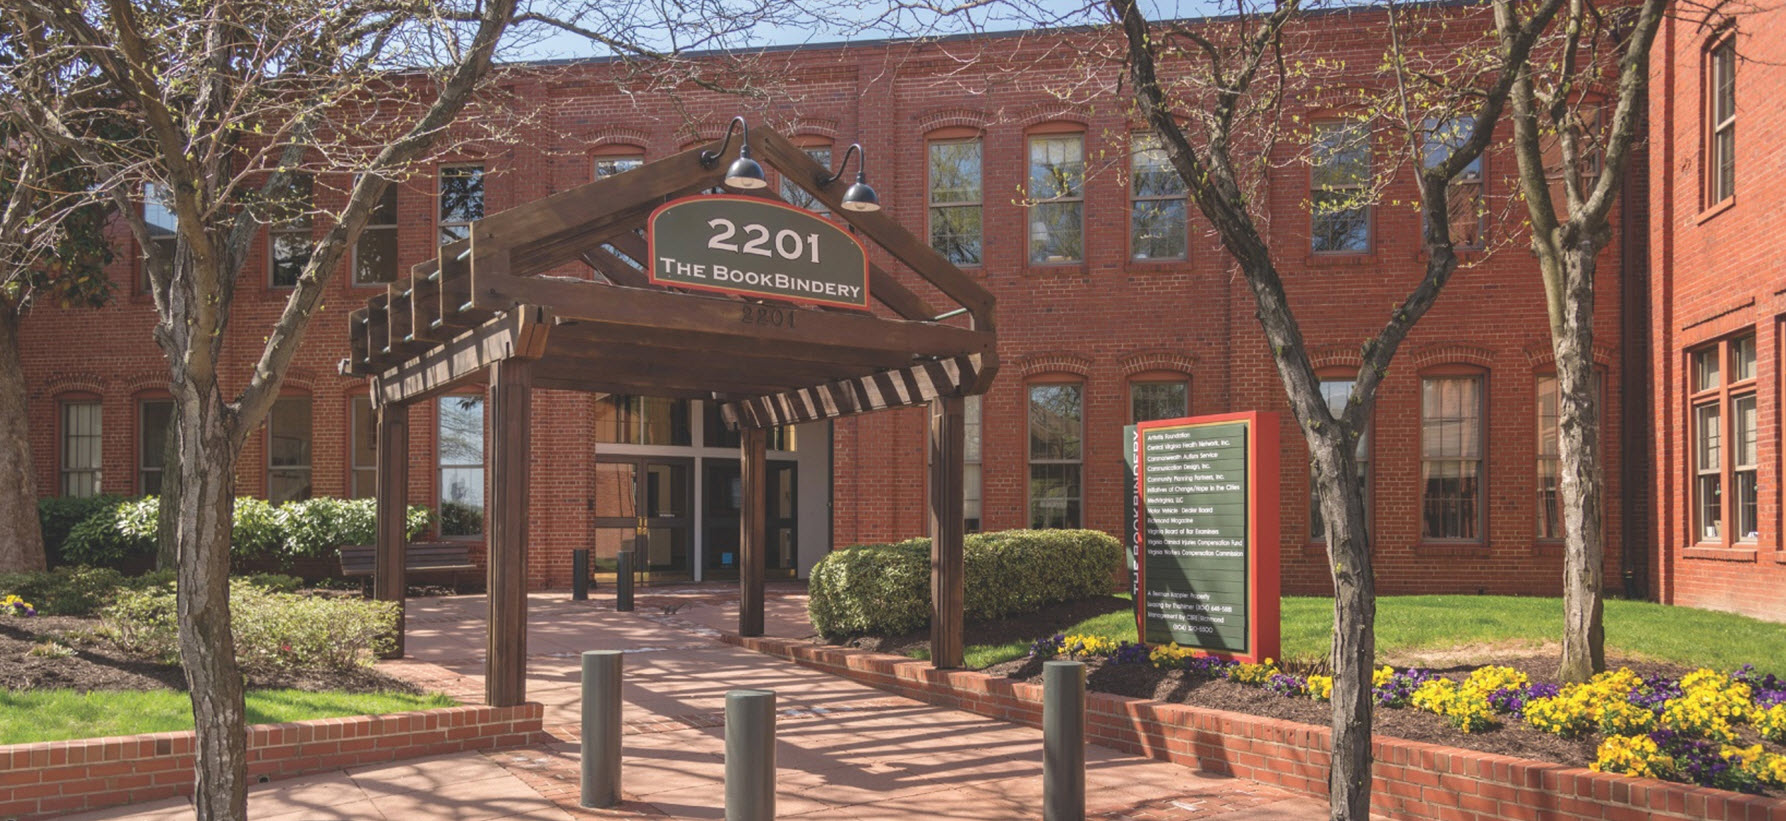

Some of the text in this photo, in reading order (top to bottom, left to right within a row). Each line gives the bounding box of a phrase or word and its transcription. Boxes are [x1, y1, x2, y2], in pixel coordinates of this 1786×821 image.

[707, 218, 820, 264] 2201
[741, 303, 797, 329] 2201
[1190, 592, 1210, 600] Property
